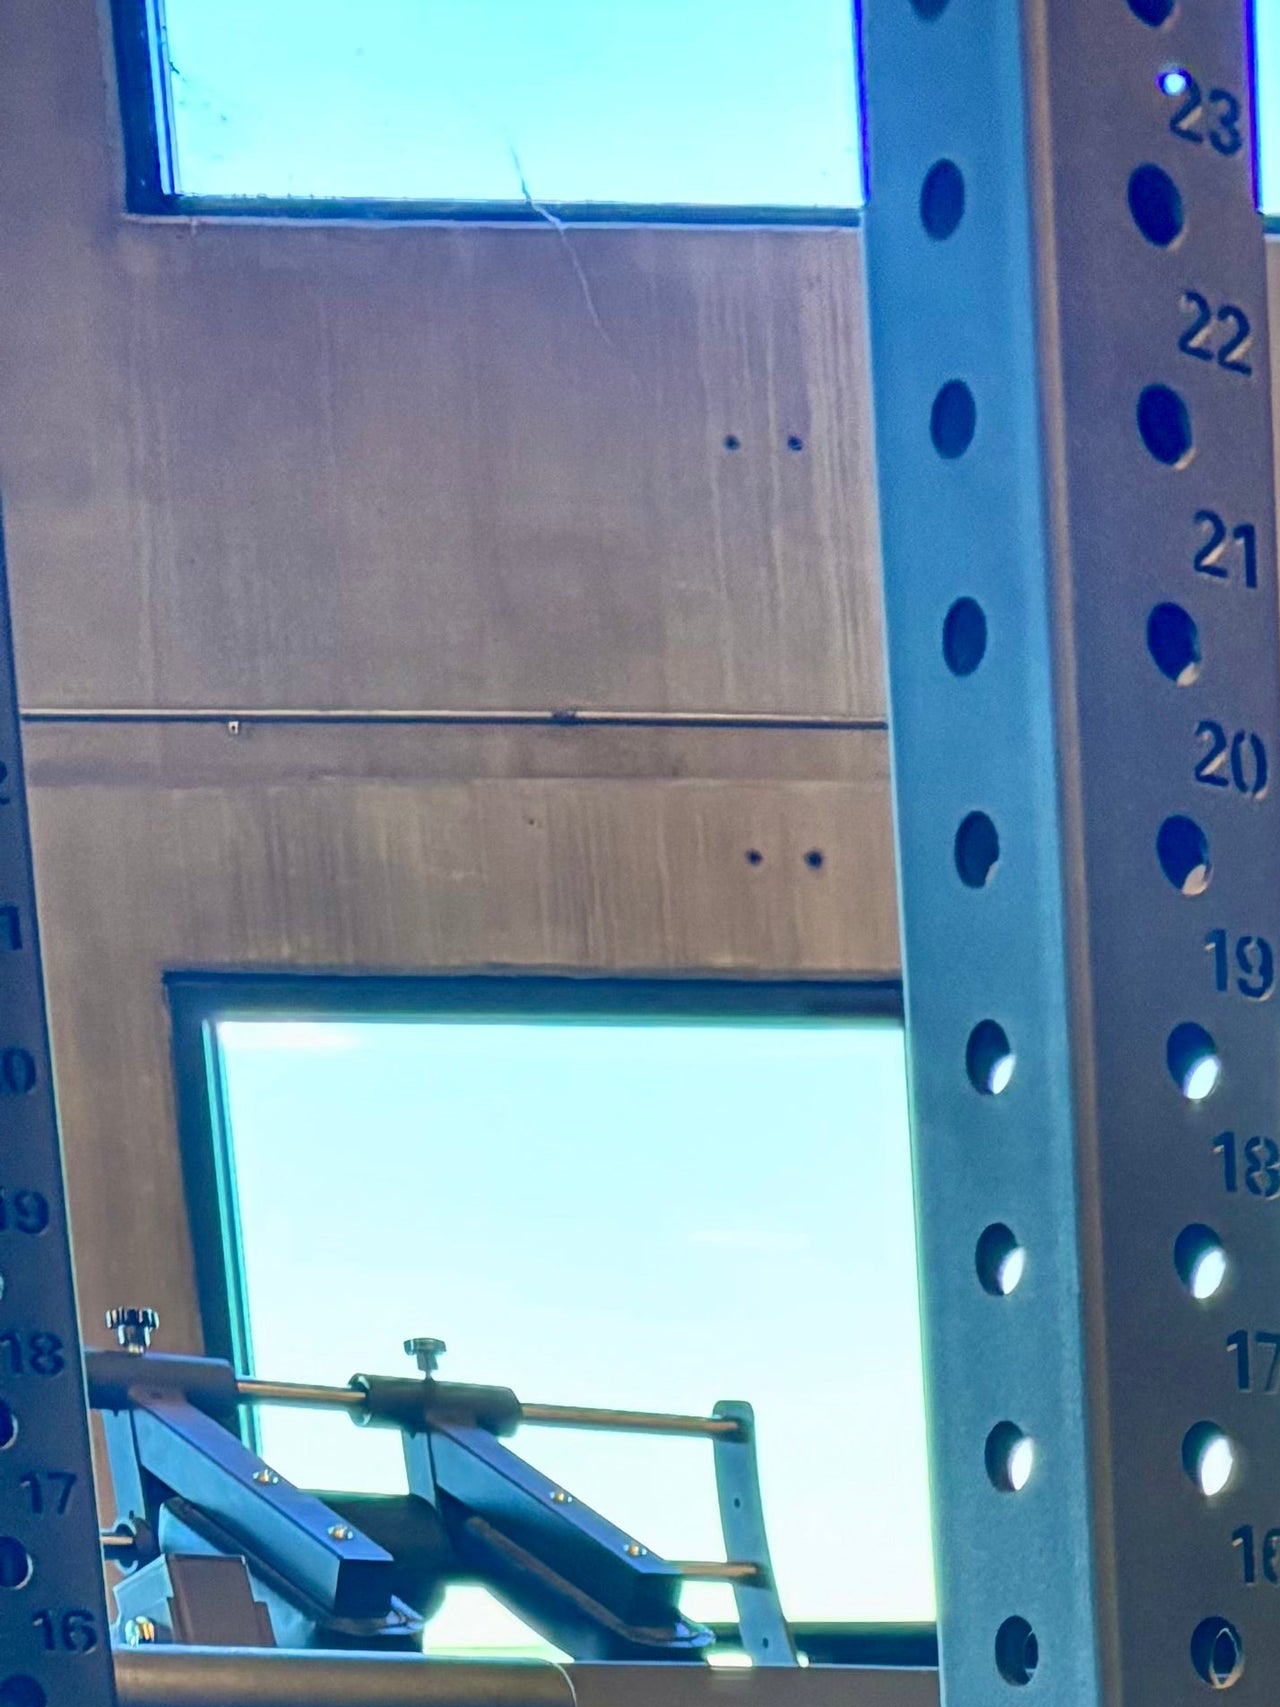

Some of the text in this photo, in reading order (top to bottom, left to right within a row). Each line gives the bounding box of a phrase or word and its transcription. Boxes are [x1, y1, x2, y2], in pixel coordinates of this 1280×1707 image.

[1169, 80, 1243, 156] 23
[1178, 290, 1253, 376] 22
[1192, 509, 1258, 589] 21
[1194, 719, 1268, 797] 20
[1203, 928, 1275, 1000] 19
[0, 1330, 66, 1378] 18
[20, 1472, 77, 1514] 17
[32, 1609, 98, 1655] 16
